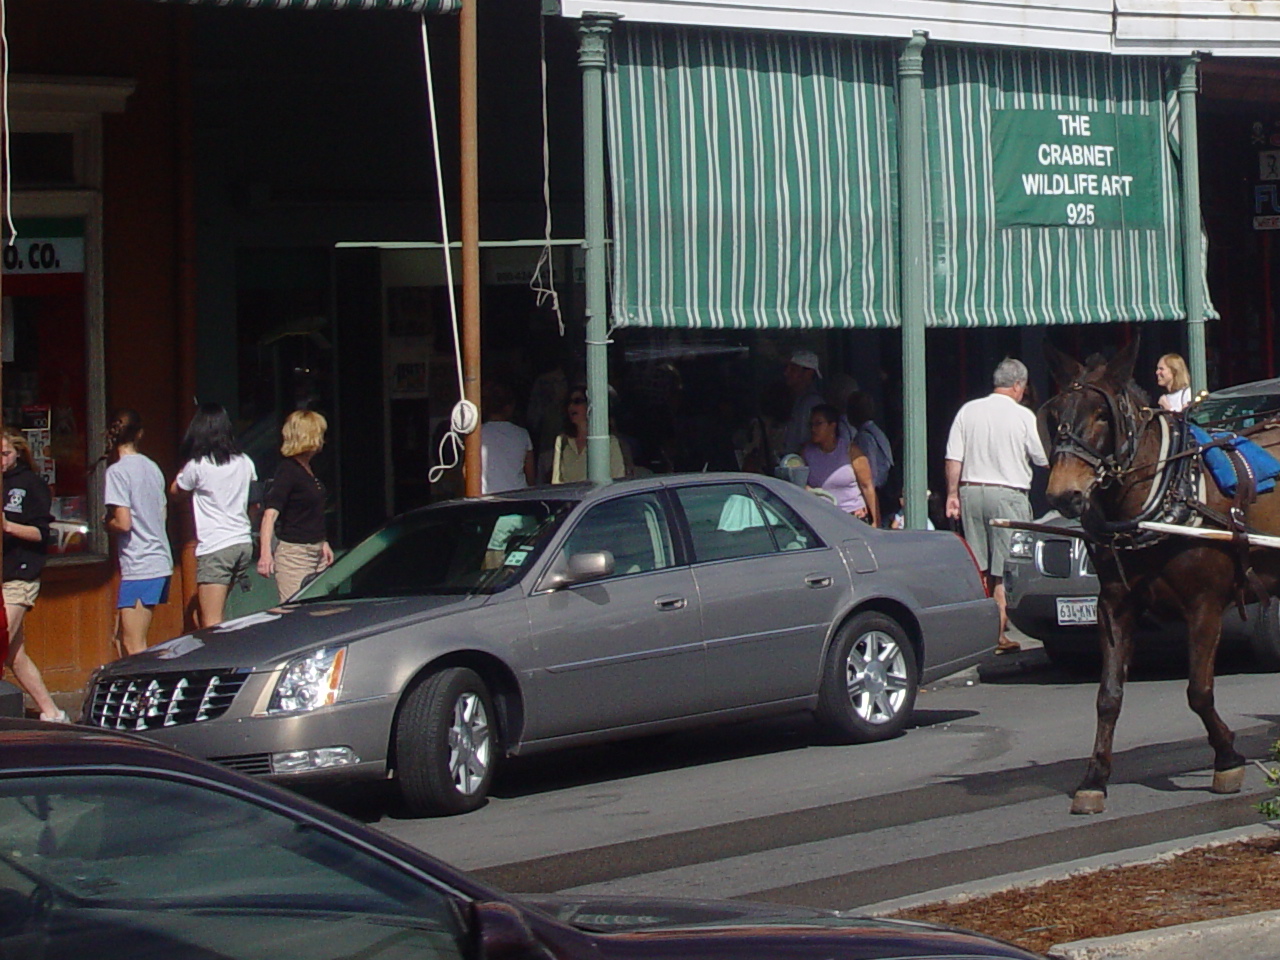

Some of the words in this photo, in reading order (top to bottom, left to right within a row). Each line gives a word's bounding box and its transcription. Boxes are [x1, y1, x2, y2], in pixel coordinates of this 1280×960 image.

[1058, 114, 1091, 136] THE
[1038, 143, 1115, 167] CRABNET
[1021, 173, 1099, 195] WILDLIFE
[1101, 174, 1134, 197] ART
[1066, 203, 1095, 225] 925
[29, 243, 60, 269] CO.
